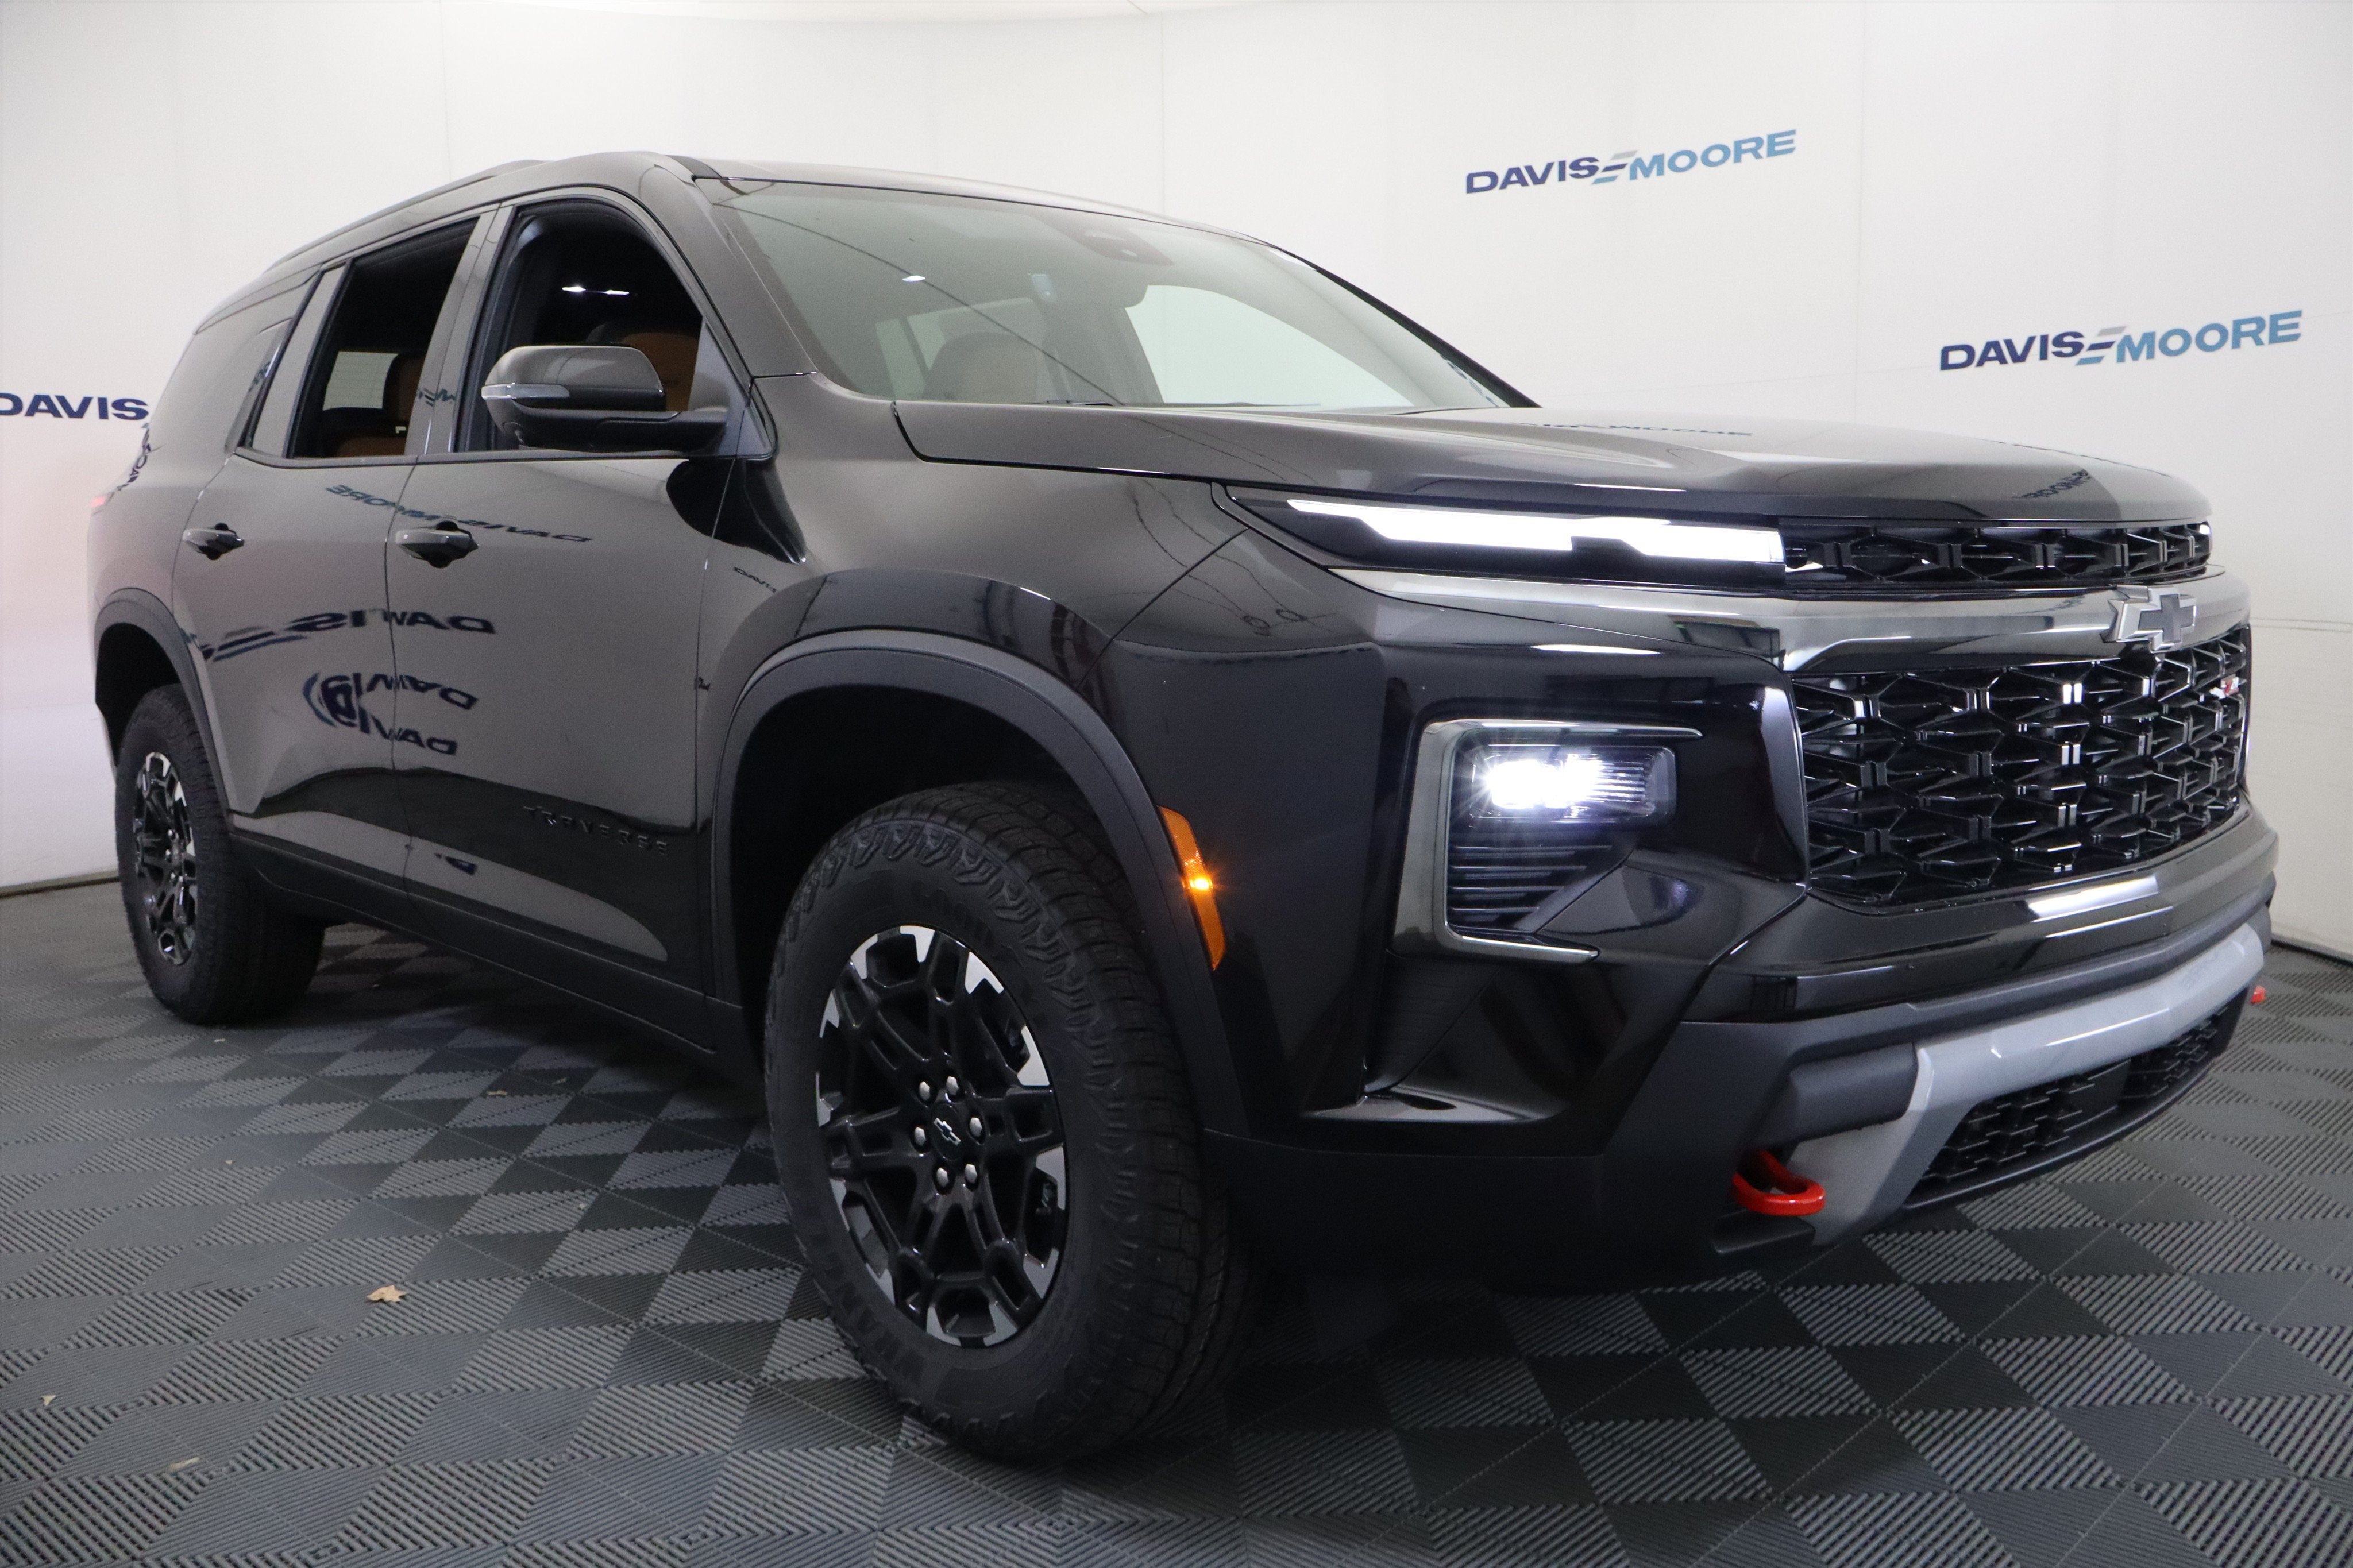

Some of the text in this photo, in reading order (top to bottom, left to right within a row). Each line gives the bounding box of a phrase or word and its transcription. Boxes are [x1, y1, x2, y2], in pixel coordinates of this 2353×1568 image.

[1465, 129, 1796, 194] DAVIS MOORE
[1939, 309, 2302, 371] DAVIS MOORE
